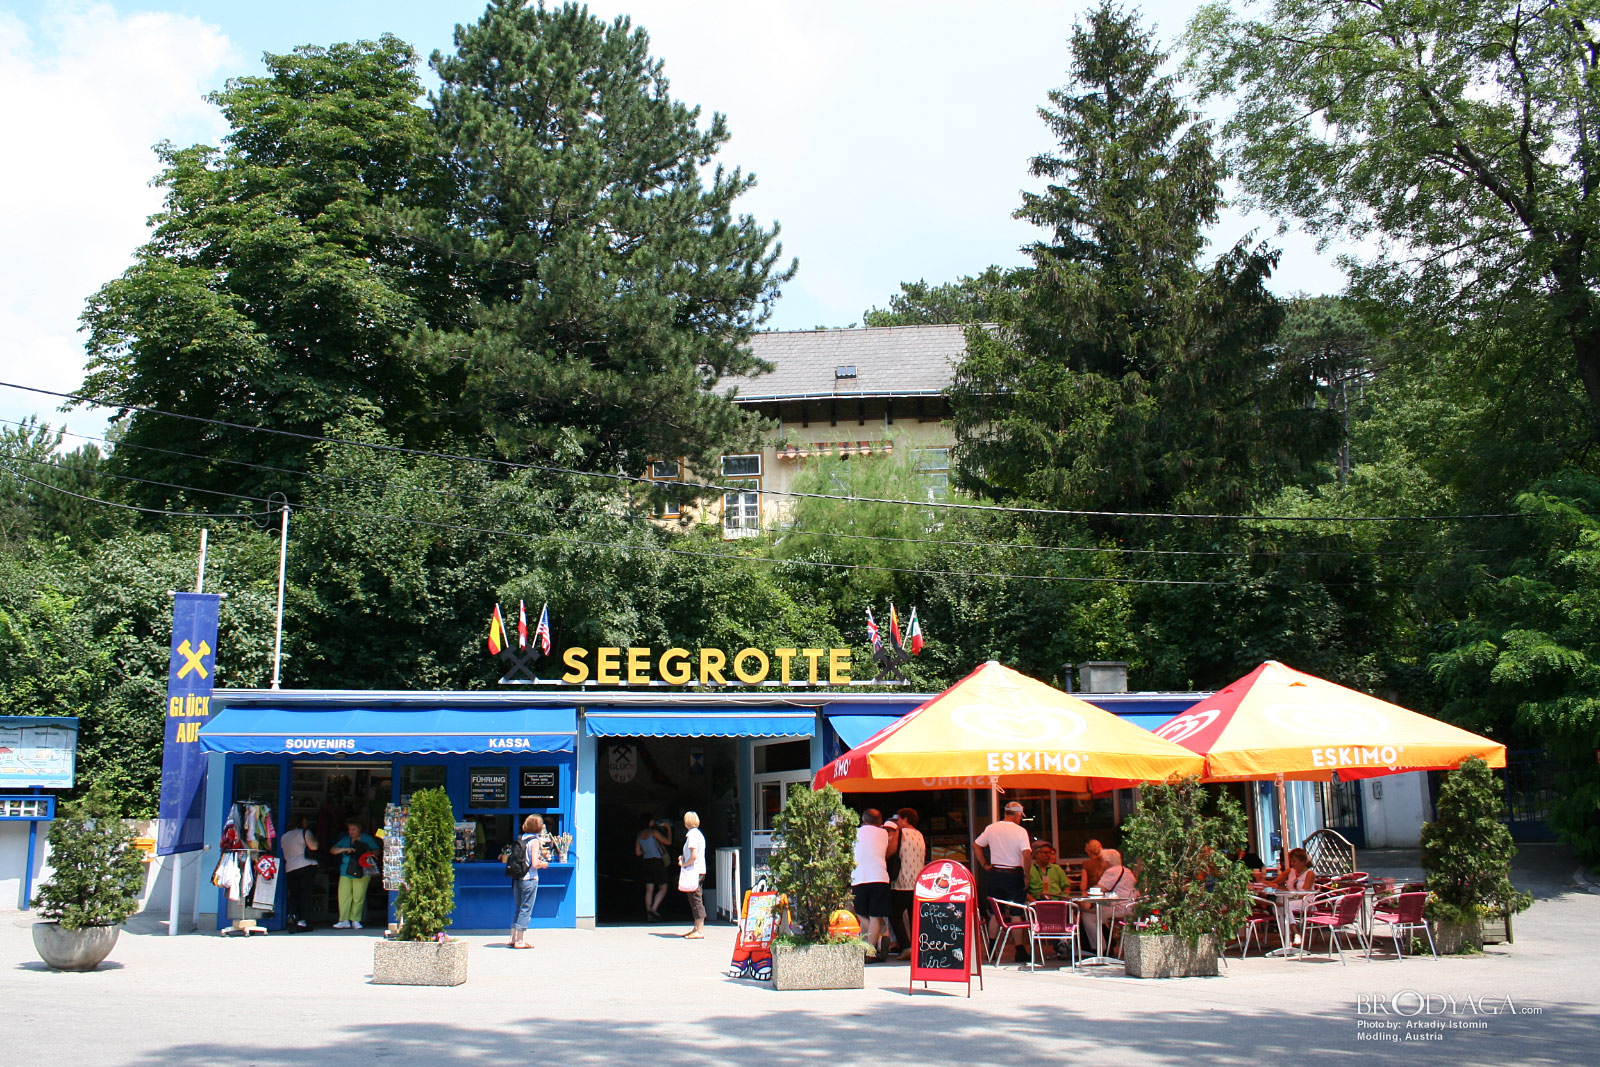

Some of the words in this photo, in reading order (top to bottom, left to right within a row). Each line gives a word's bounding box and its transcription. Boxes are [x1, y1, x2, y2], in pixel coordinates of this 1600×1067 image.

[562, 646, 851, 684] SEEGROTTE
[170, 693, 210, 717] GLÜCK
[176, 722, 202, 743] AUF
[285, 738, 355, 749] SOUVENIRS
[488, 738, 531, 748] KASSA
[472, 775, 506, 783] FÜHRUNG
[920, 903, 949, 923] Coffee
[919, 933, 955, 951] Beer
